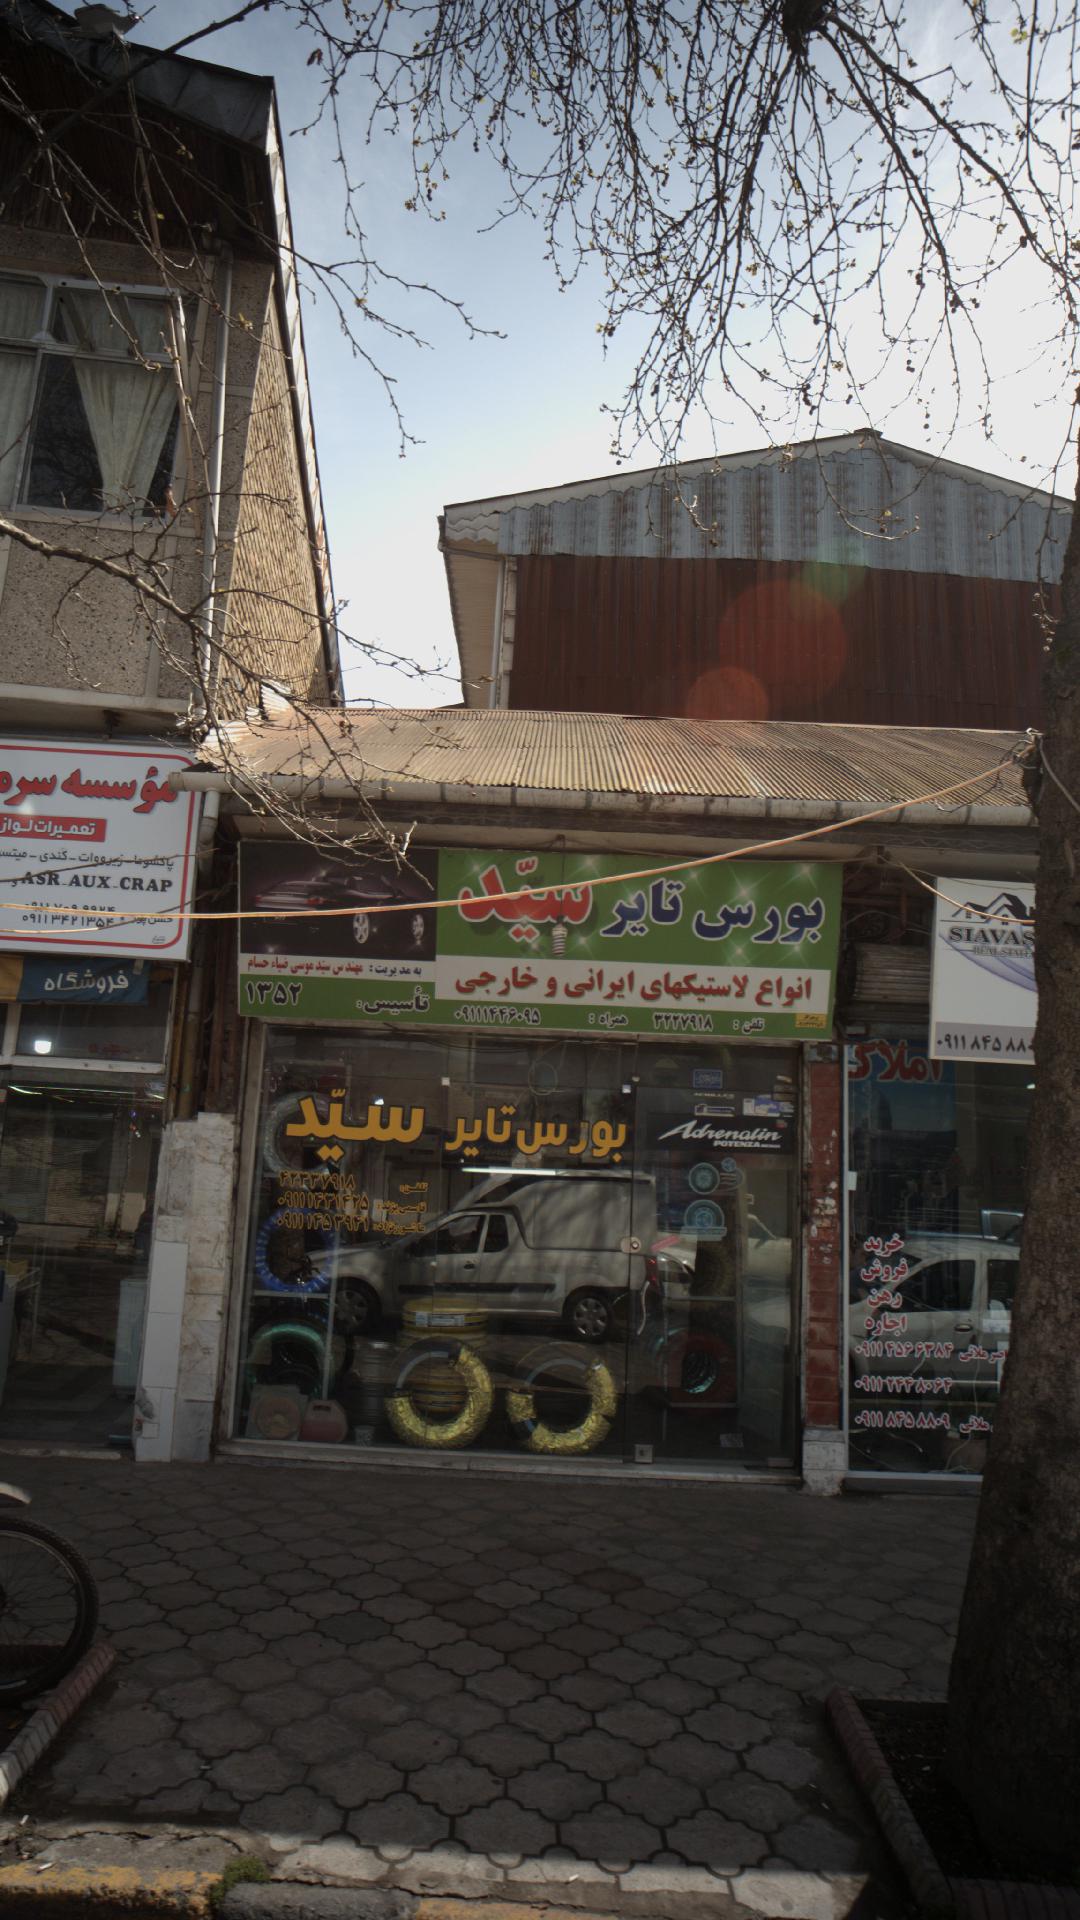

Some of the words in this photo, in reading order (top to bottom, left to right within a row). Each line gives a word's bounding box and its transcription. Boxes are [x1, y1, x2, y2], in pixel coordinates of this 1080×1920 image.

[34, 819, 96, 838] تعمیرات
[69, 874, 112, 889] AUX
[120, 877, 174, 892] CRAP
[600, 878, 686, 937] تایر
[692, 896, 825, 945] بورس
[44, 970, 129, 994] فروشگاه
[245, 980, 302, 1006] ۱۳۵۲
[455, 965, 538, 997] خارجی
[564, 967, 635, 998] ایرانی
[755, 975, 812, 1007] انواع
[444, 1103, 517, 1158] تایر
[516, 1117, 628, 1164] بورس
[658, 1119, 783, 1141] Adrenalin
[864, 1233, 904, 1257] خرید
[861, 1257, 909, 1282] فروش
[867, 1288, 903, 1309] رهن
[864, 1312, 907, 1336] اجاره
